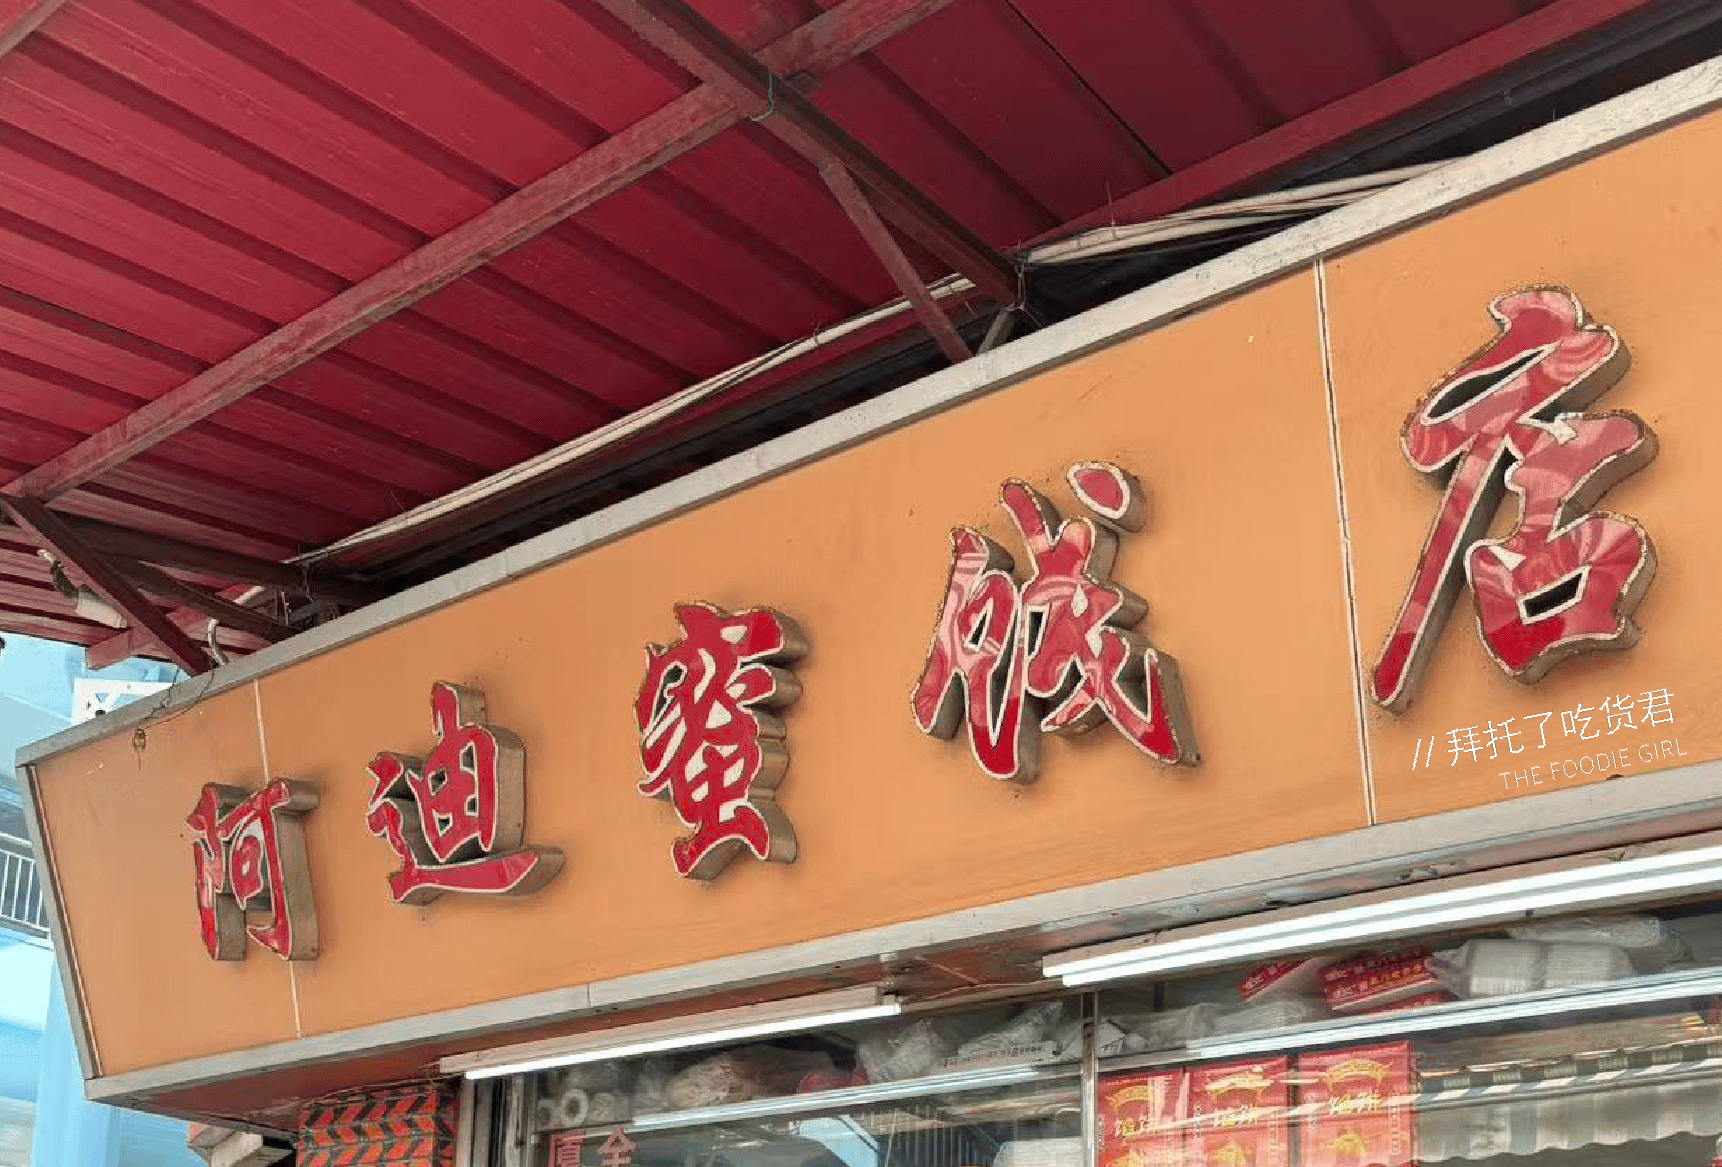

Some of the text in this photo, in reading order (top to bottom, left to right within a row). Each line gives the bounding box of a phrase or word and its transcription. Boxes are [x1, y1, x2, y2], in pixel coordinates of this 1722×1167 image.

[185, 285, 1658, 961] 阿迪蜜饯店
